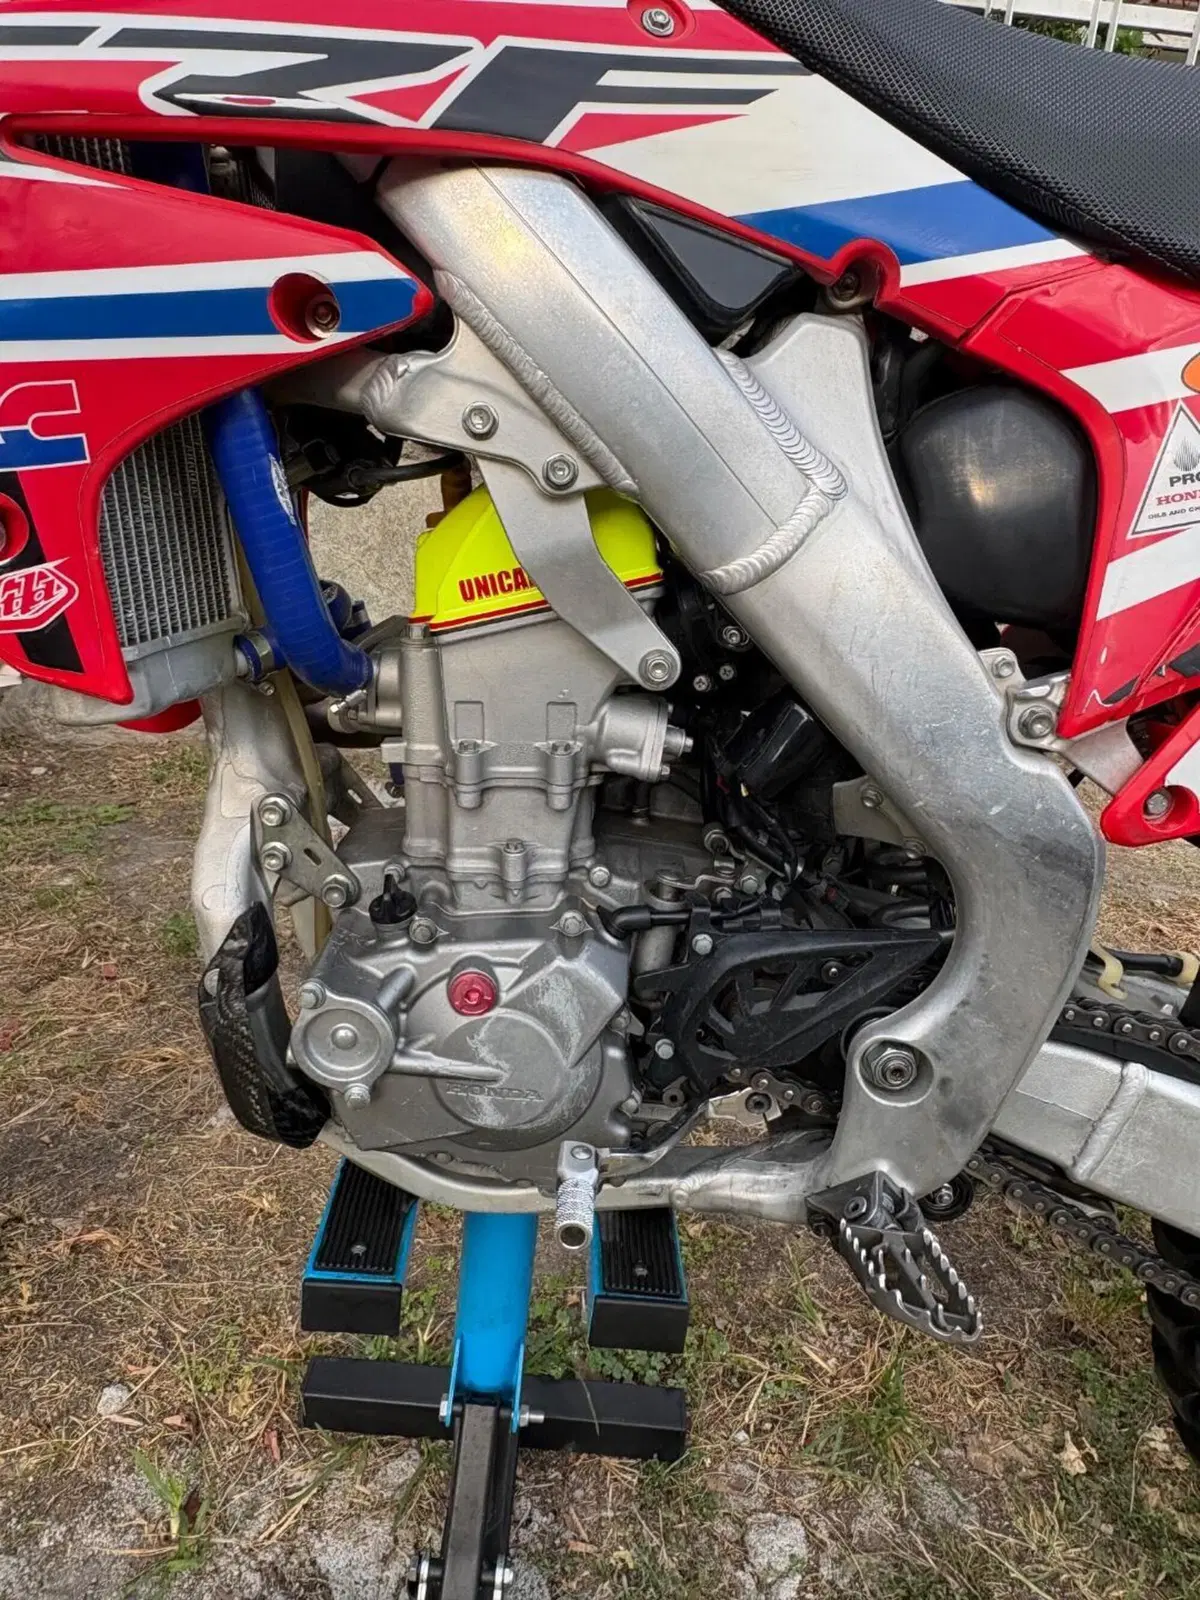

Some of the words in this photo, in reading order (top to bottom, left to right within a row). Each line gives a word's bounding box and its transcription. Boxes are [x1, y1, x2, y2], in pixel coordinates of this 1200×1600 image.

[1169, 508, 1187, 516] AND
[458, 566, 537, 603] UNICA
[446, 1081, 545, 1103] HONDA
